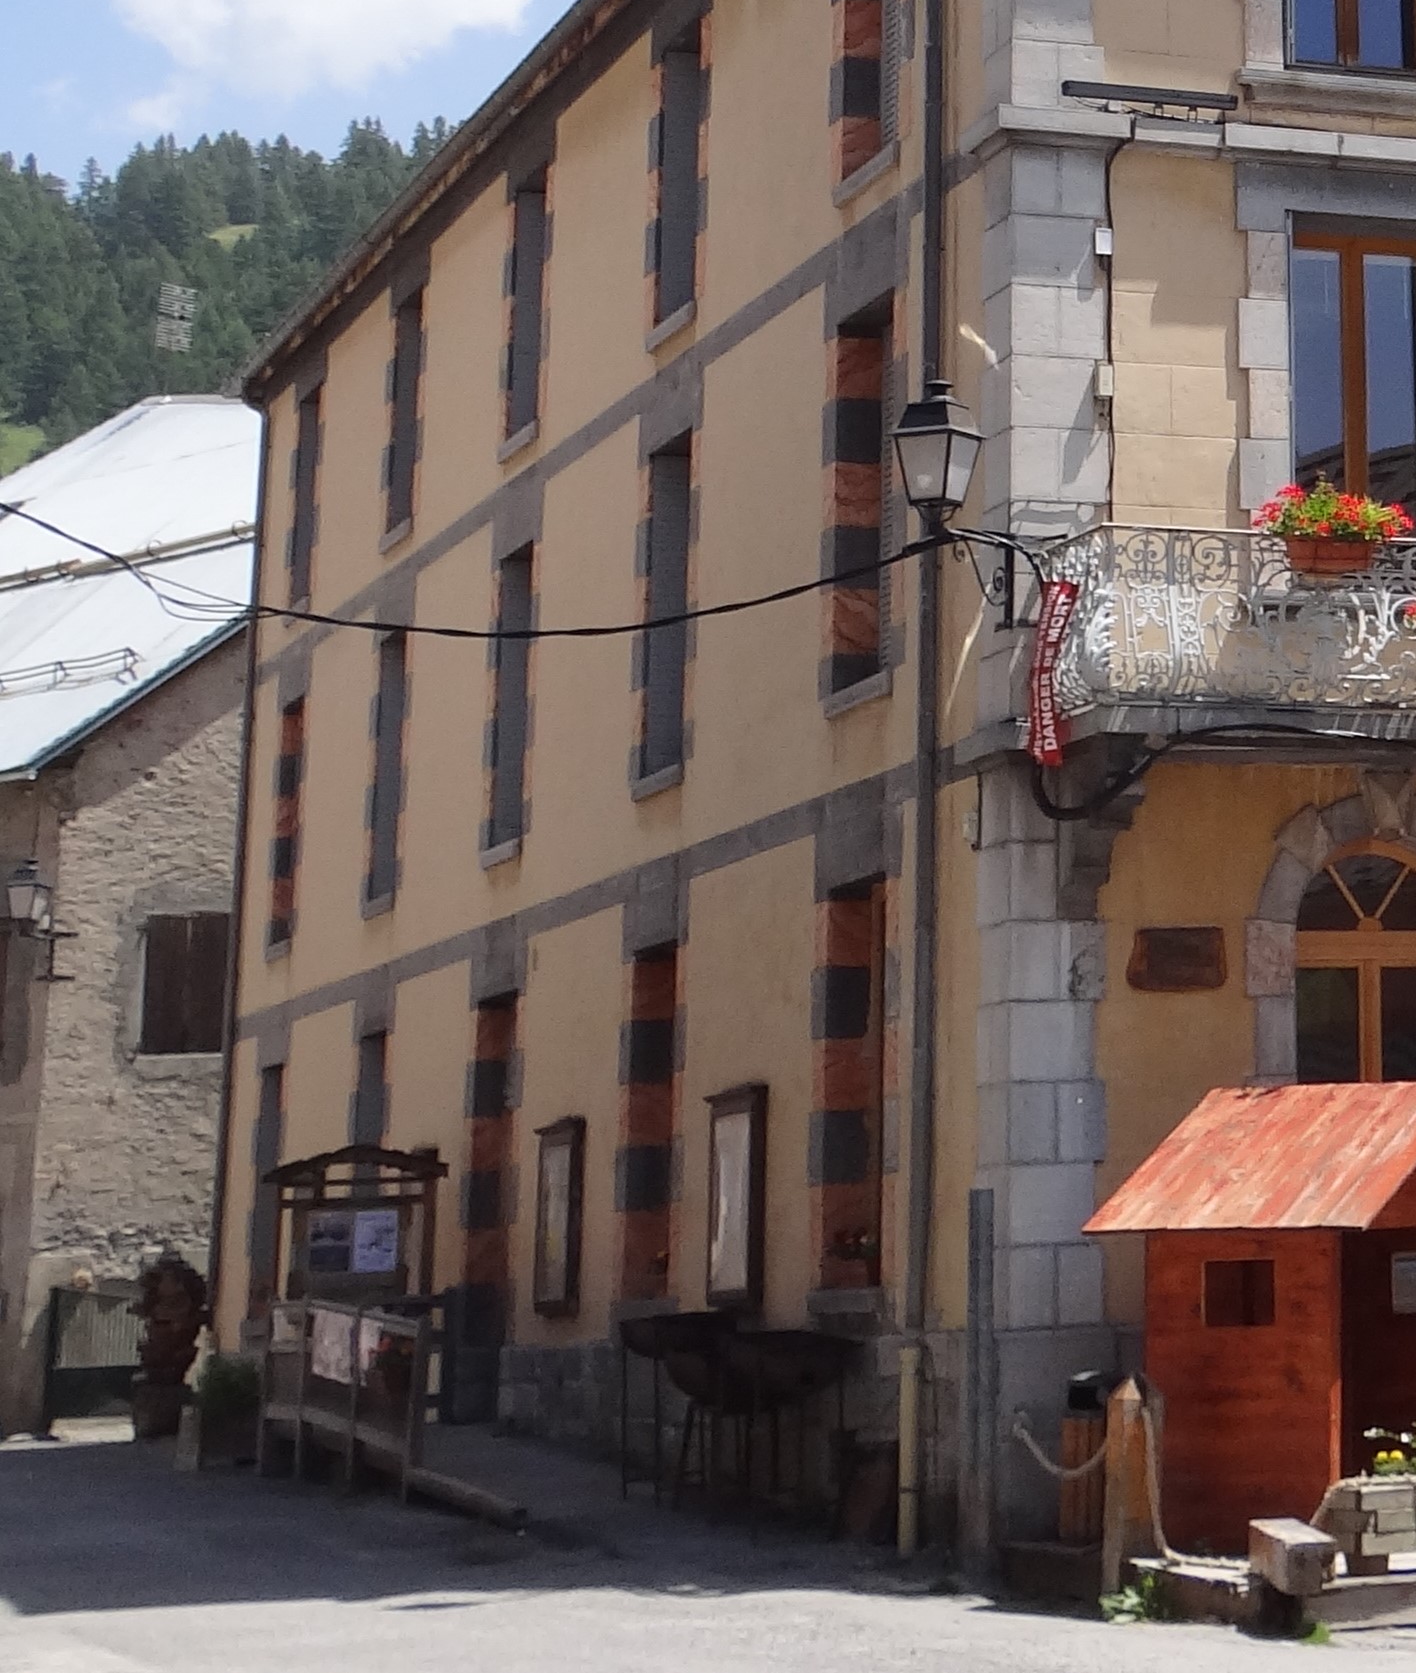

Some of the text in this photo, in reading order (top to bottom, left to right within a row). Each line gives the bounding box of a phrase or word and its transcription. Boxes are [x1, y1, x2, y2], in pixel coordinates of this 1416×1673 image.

[1040, 594, 1072, 751] DANGER DE MORT
